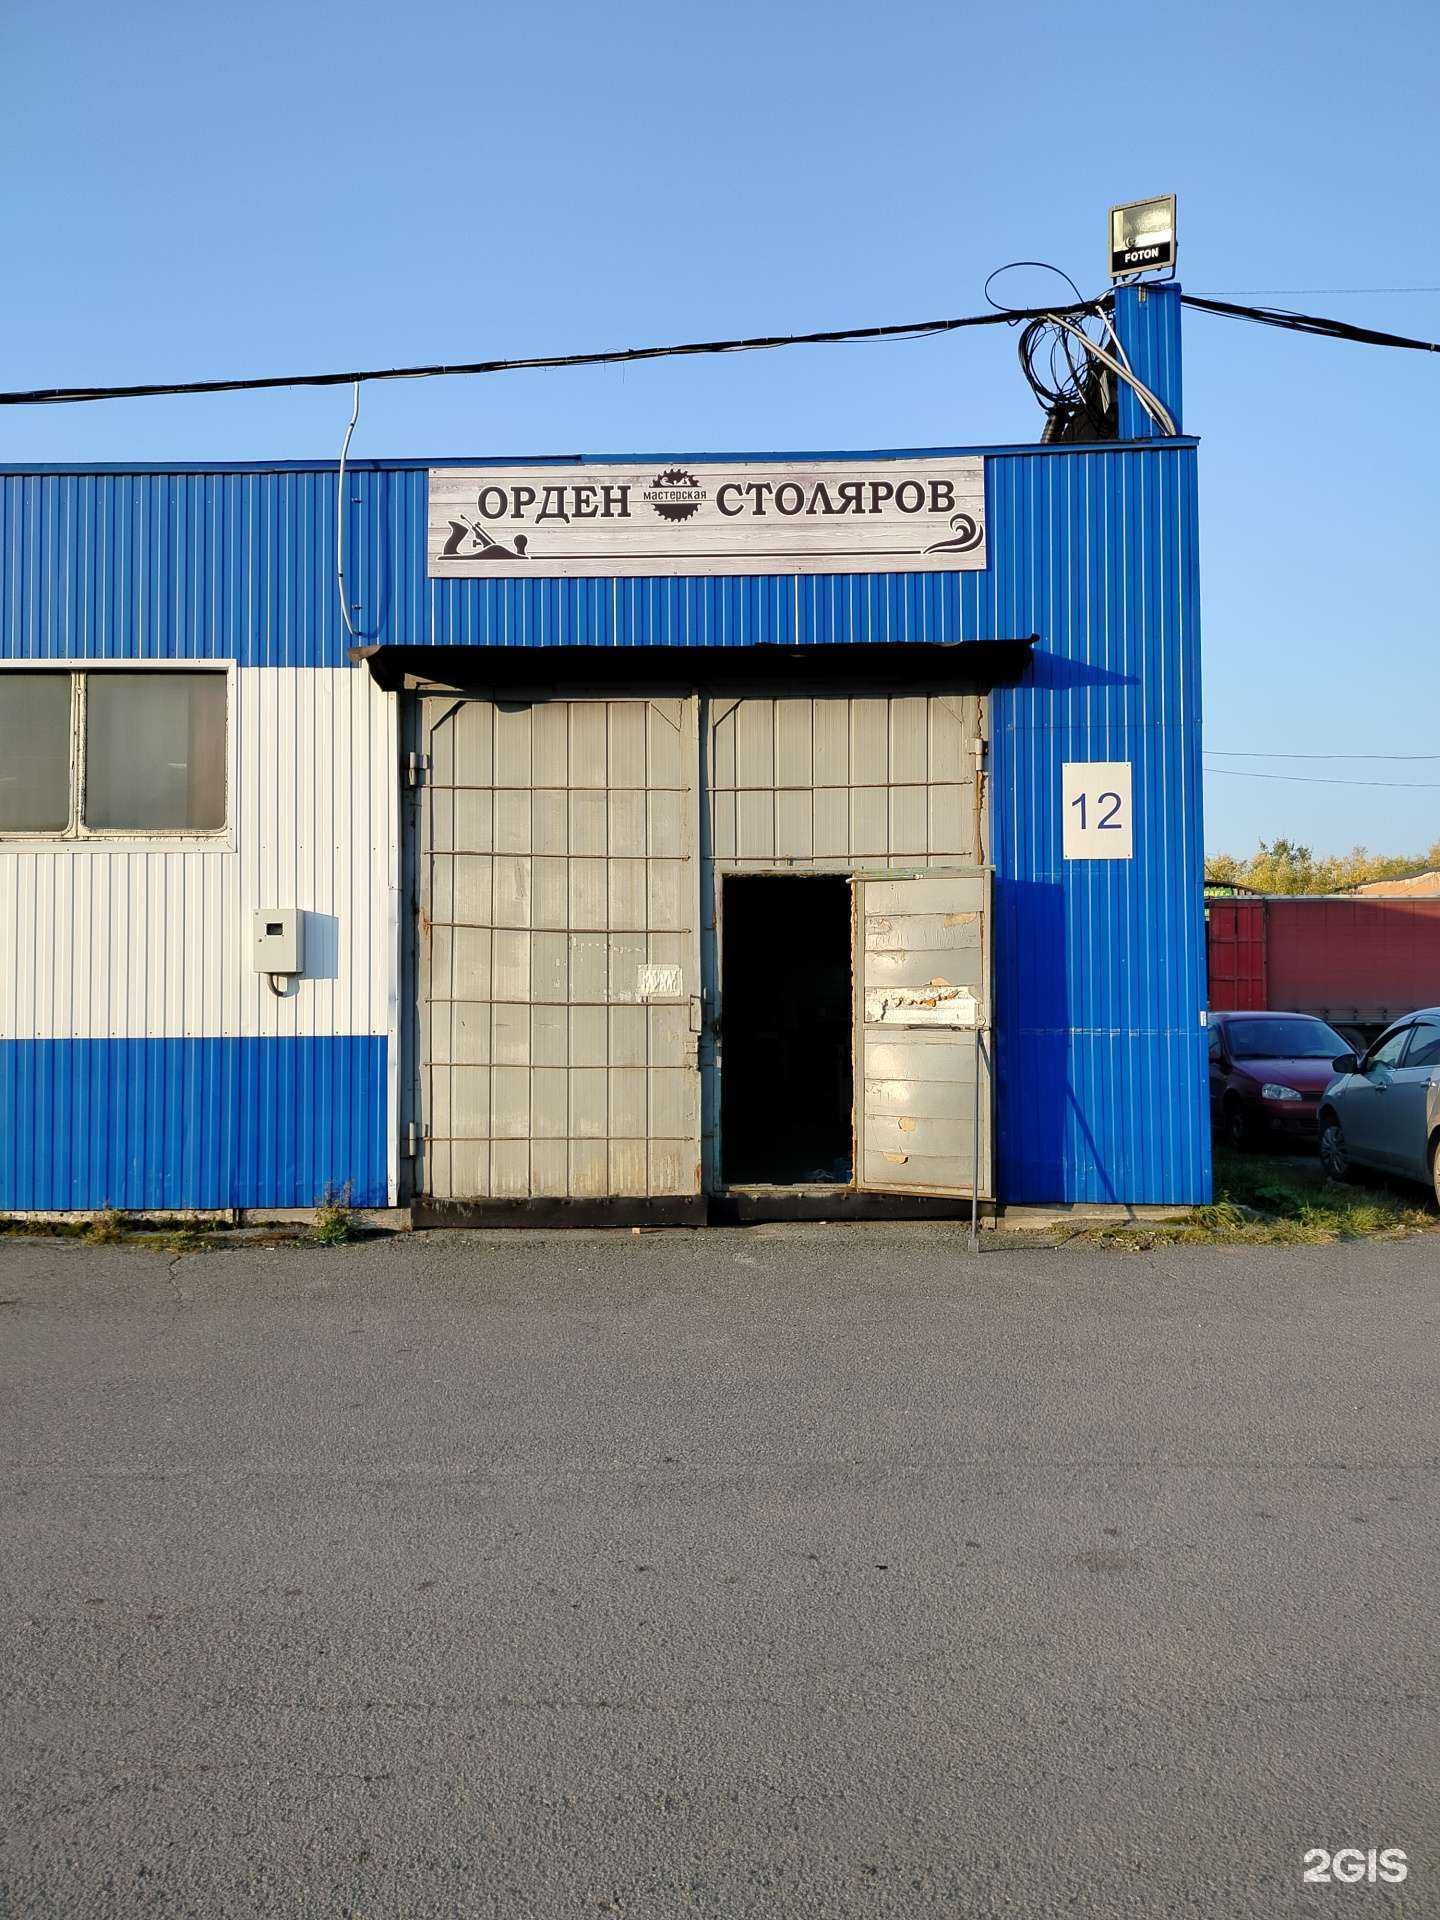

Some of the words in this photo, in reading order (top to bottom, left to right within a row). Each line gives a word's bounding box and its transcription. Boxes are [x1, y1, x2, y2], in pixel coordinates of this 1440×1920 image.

[1125, 247, 1159, 263] FOTON
[478, 485, 632, 524] ОРДЕН
[643, 489, 707, 502] мастерская
[716, 480, 956, 516] СТОЛЯРОВ
[1072, 792, 1122, 830] 12
